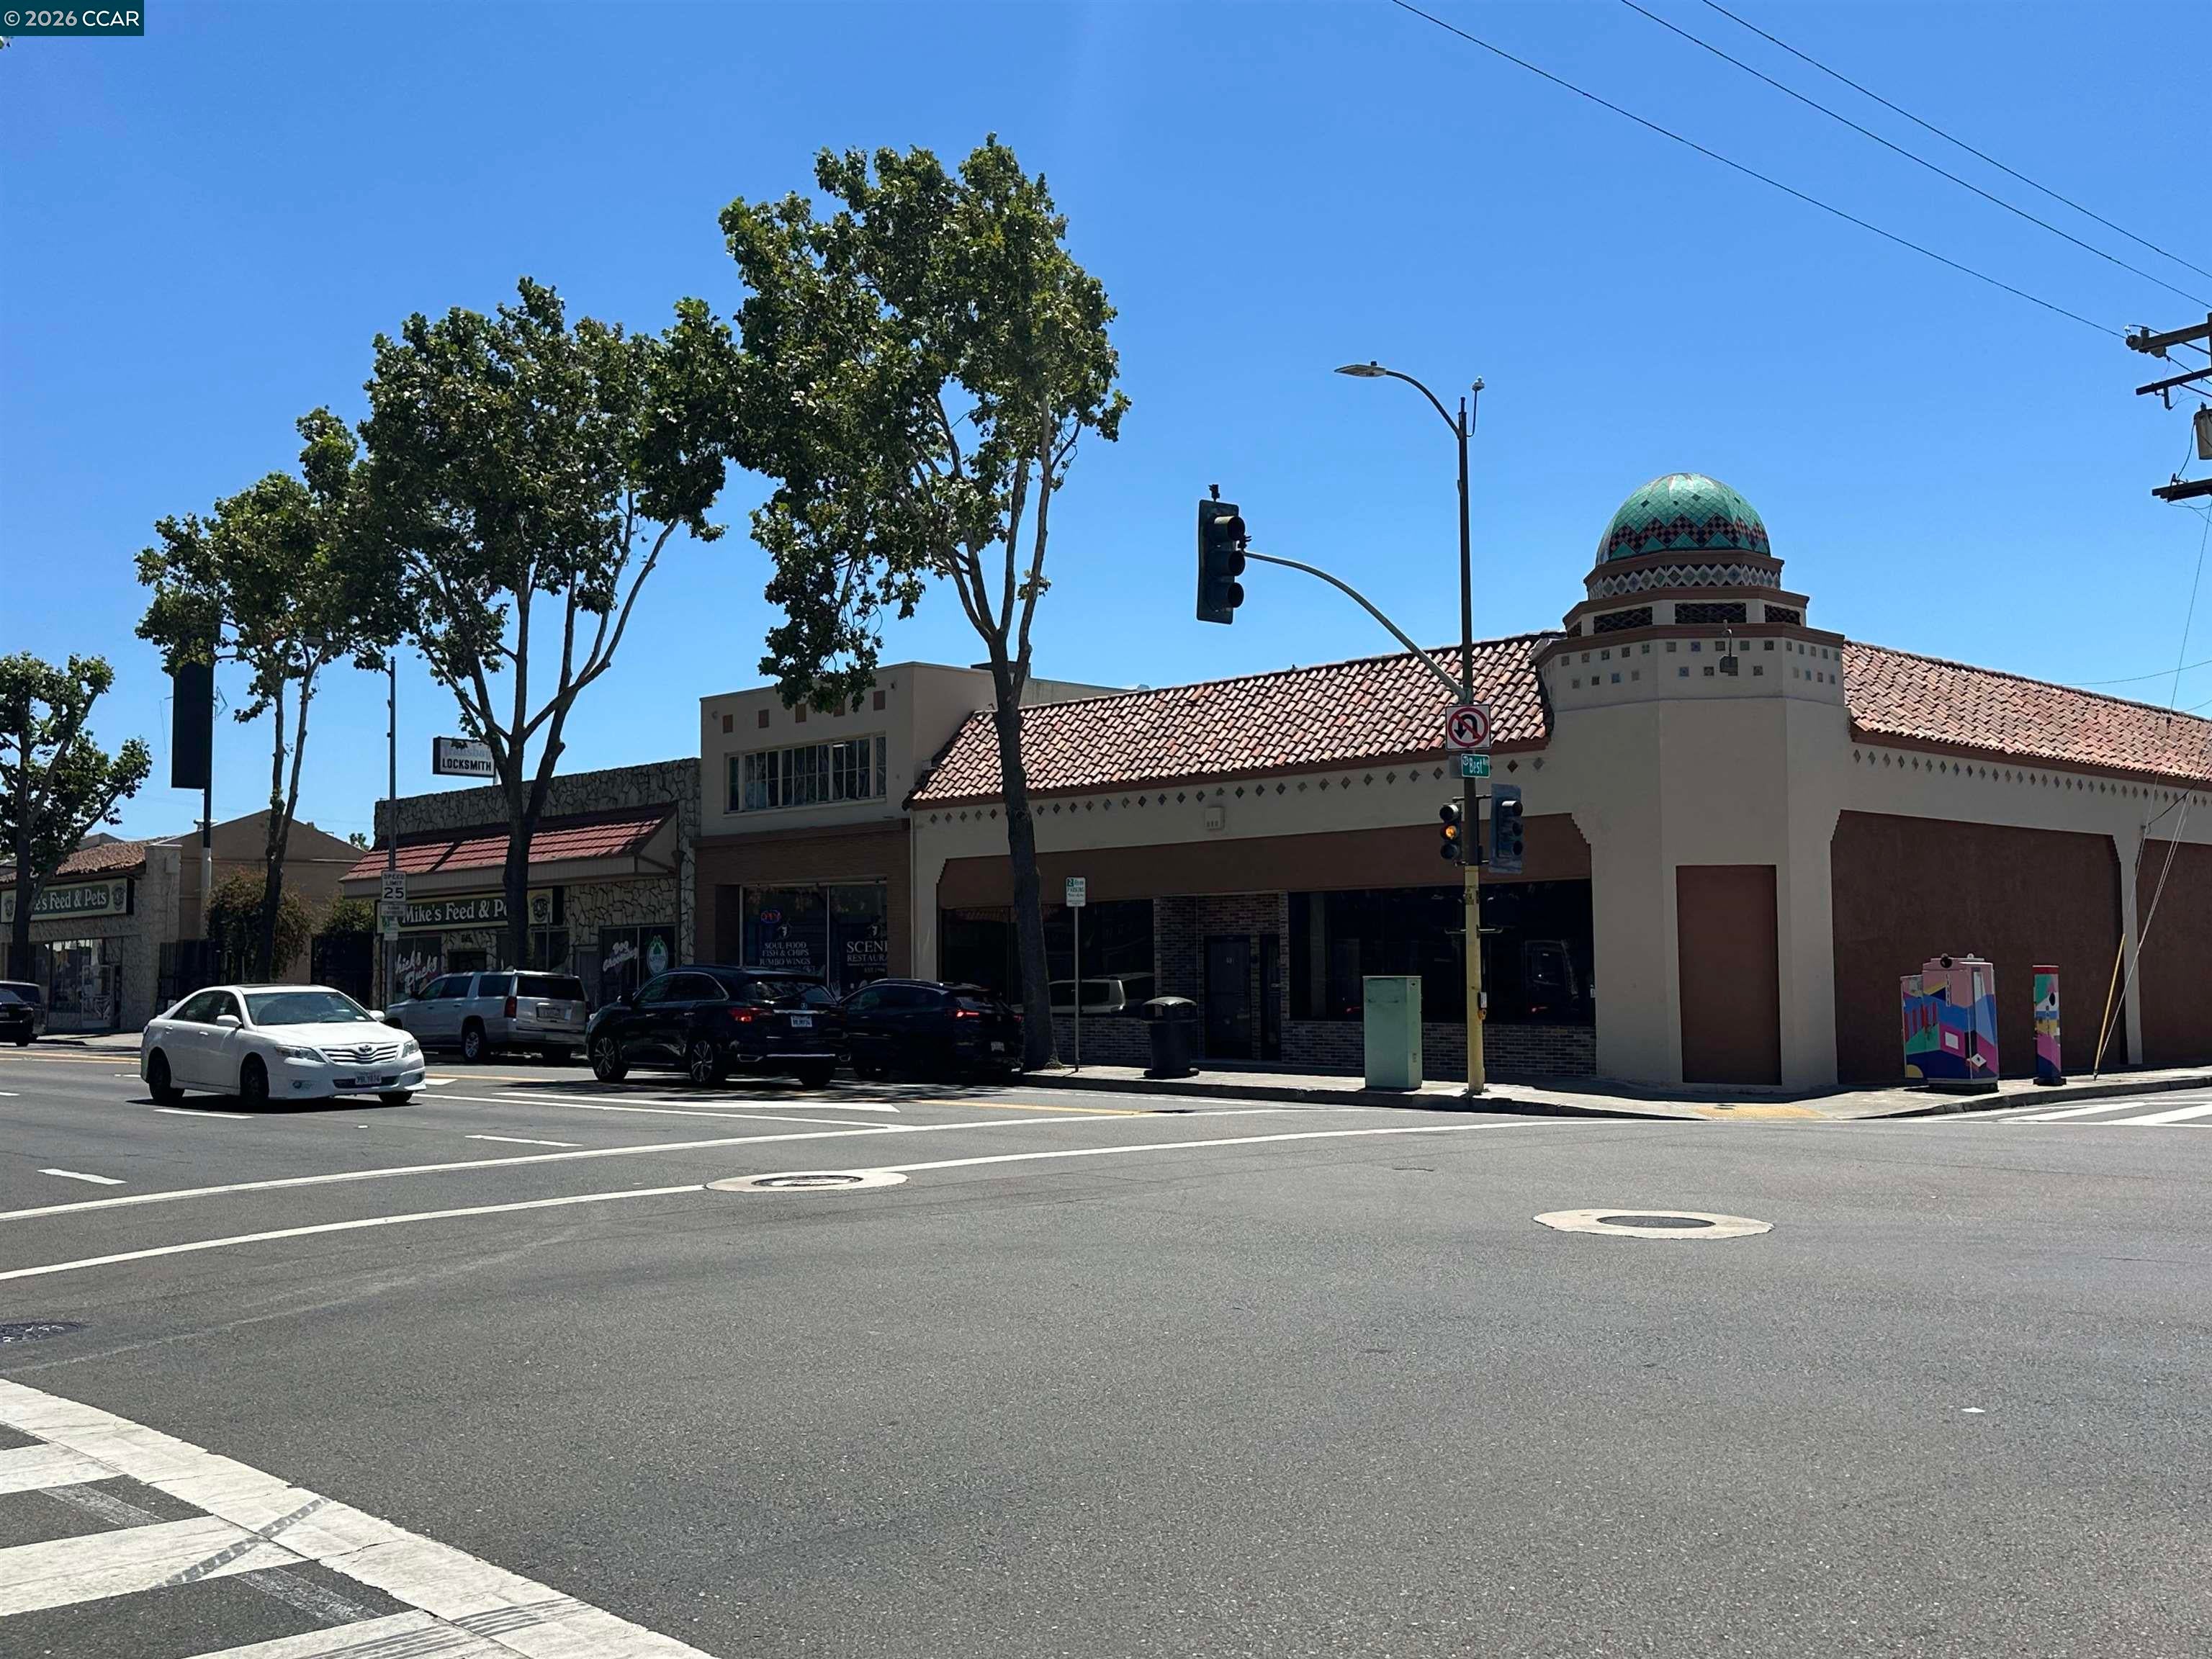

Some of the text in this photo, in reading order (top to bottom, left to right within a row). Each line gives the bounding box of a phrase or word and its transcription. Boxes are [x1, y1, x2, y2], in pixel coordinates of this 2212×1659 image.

[442, 757, 492, 772] LOCKSMITH
[1469, 757, 1483, 774] Best
[50, 889, 71, 909] Feed
[73, 889, 82, 908] &
[84, 889, 107, 907] Pets
[384, 887, 404, 899] 25
[402, 902, 442, 924] Mike's
[445, 902, 475, 921] Feed
[477, 899, 490, 919] &
[764, 940, 807, 950] SOUL FOOD
[762, 949, 778, 958] FISH
[786, 948, 809, 957] CHIPS
[395, 950, 422, 975] hicks
[759, 957, 811, 966] JUMBO WINGS
